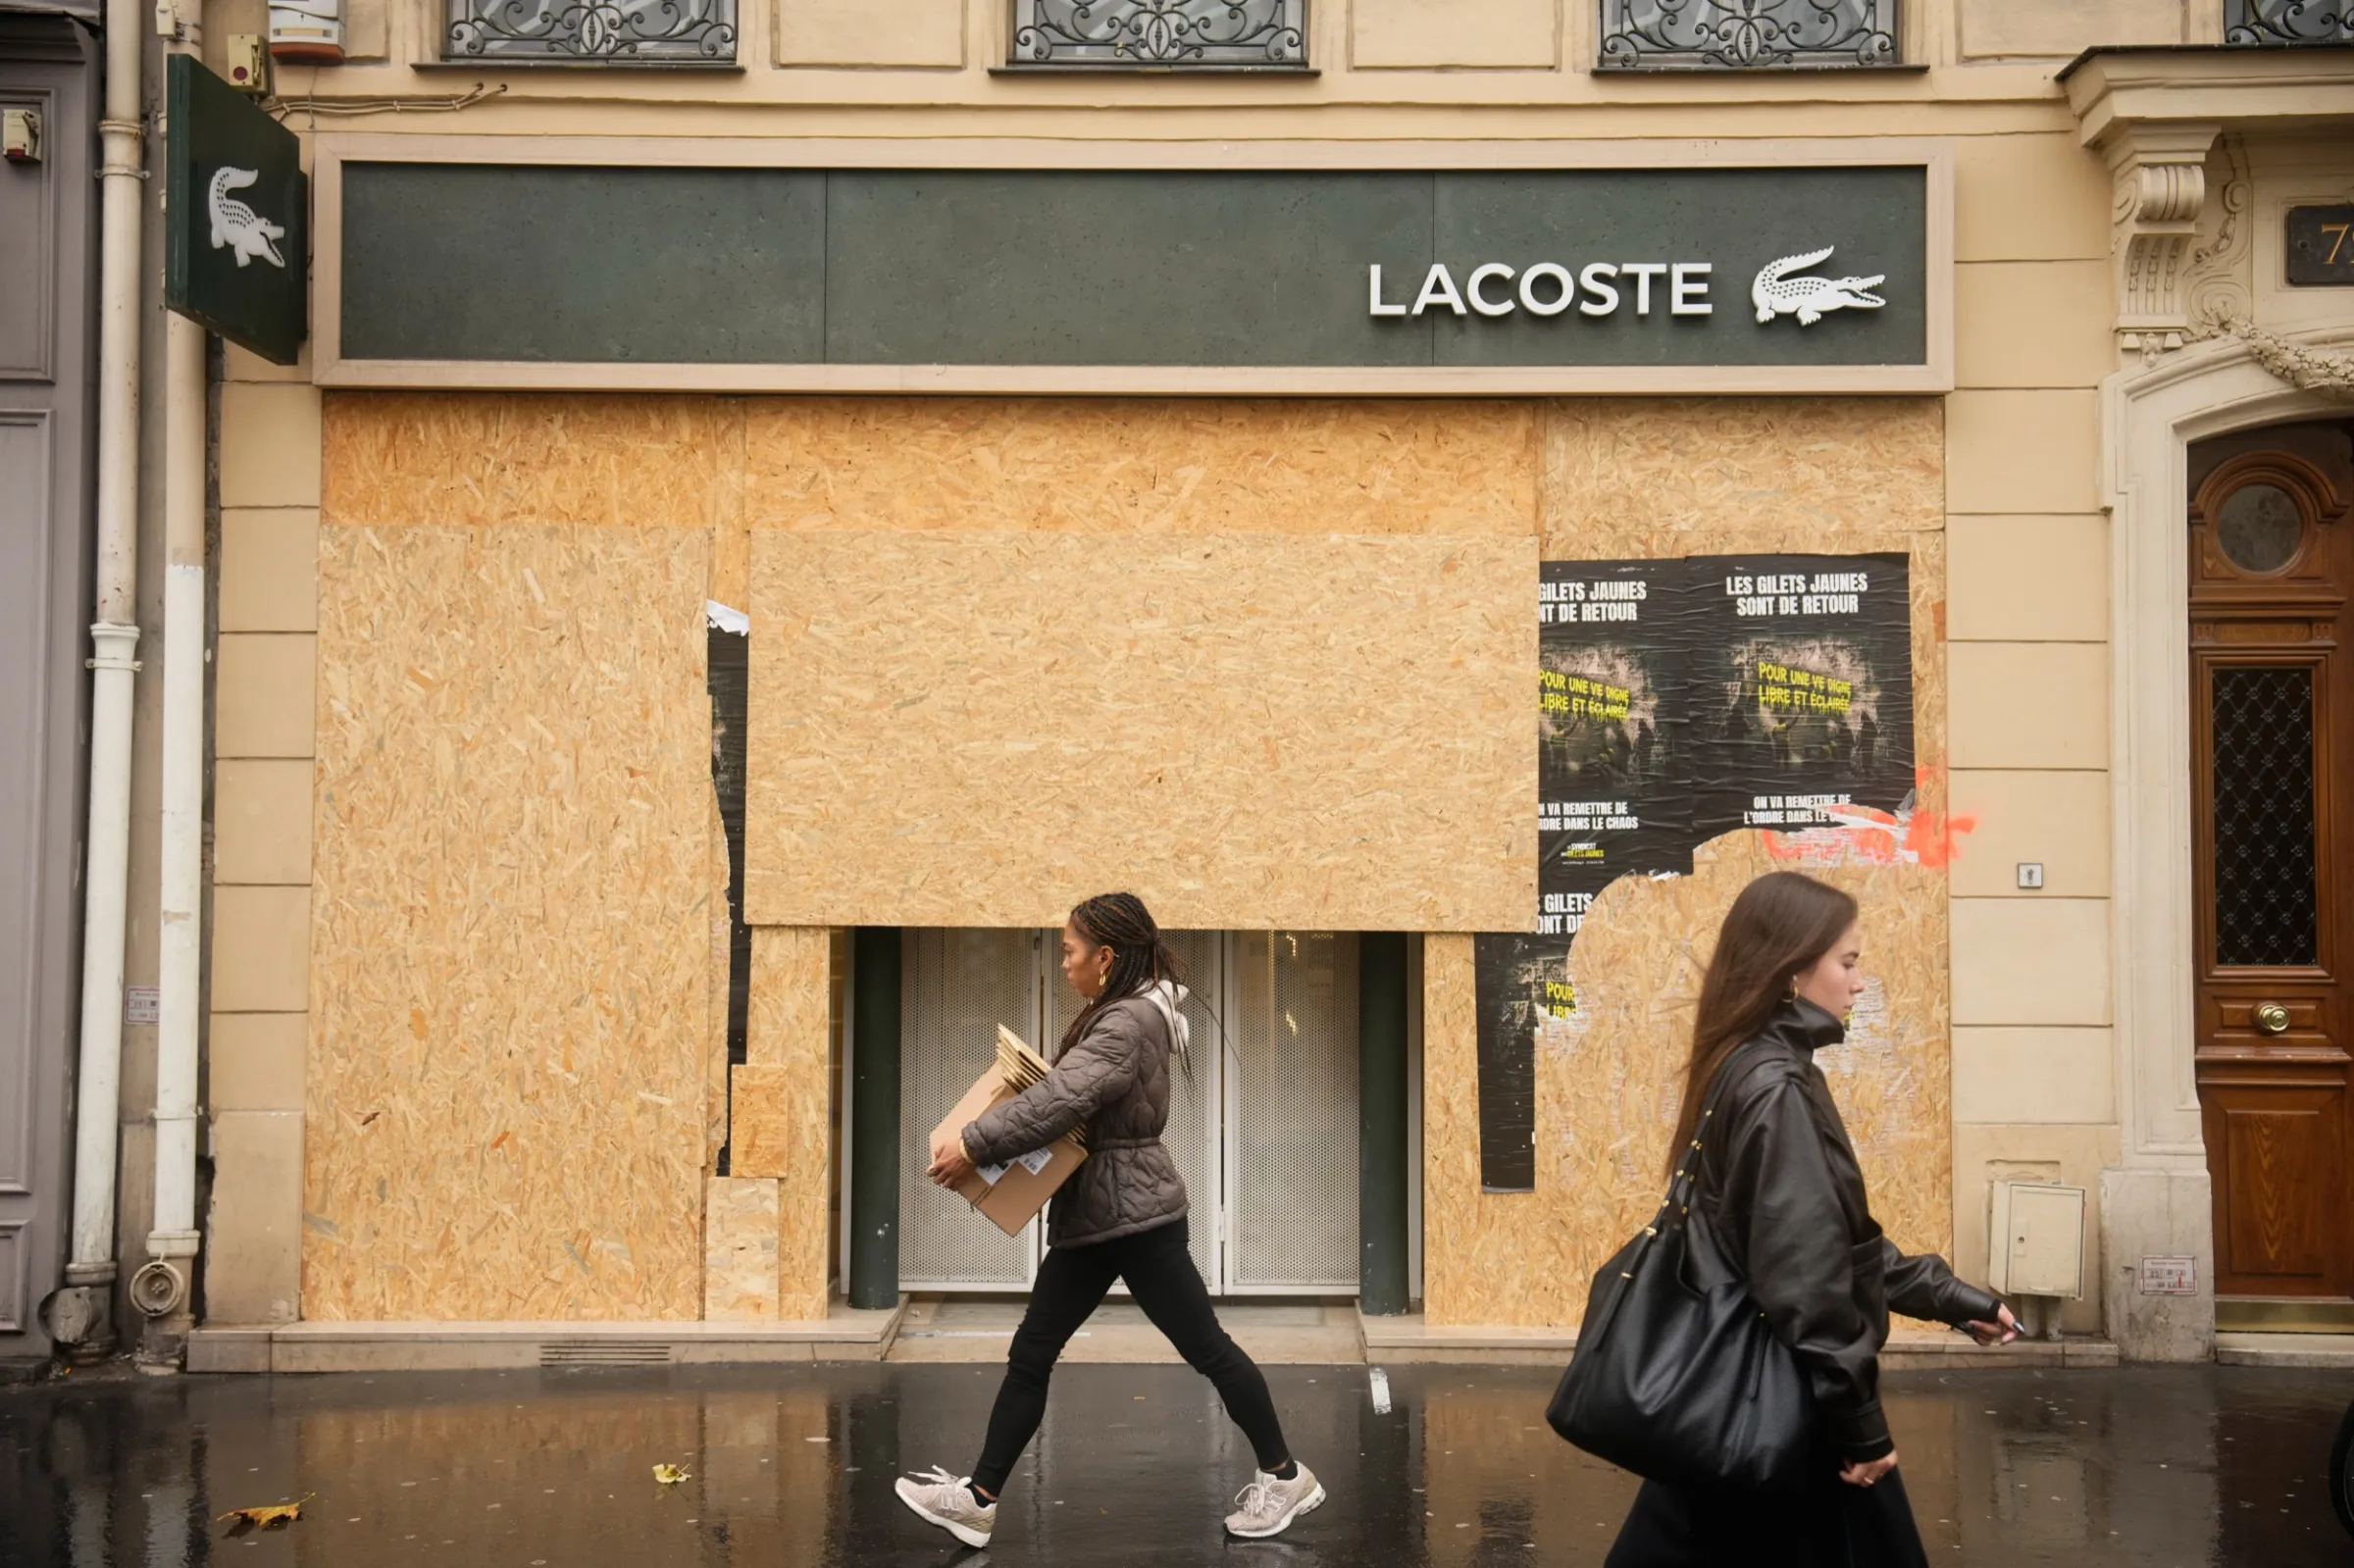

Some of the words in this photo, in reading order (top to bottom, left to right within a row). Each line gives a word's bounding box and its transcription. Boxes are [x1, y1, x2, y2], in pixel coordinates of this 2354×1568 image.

[2321, 223, 2354, 265] 7
[1369, 262, 1713, 316] LACOSTE
[1539, 582, 1586, 601] GILETS
[1589, 581, 1647, 600] JAUNES
[1726, 576, 1753, 595] LES
[1757, 575, 1806, 594] GILETS
[1810, 573, 1868, 592] JAUNES
[1539, 603, 1555, 623] NT
[1559, 603, 1577, 623] DE
[1581, 602, 1638, 622] RETOUR
[1736, 596, 1774, 616] SONT
[1779, 595, 1799, 615] DE
[1802, 594, 1859, 614] RETOUR
[1539, 669, 1566, 690] POUR
[1568, 677, 1589, 695] UNE
[1606, 685, 1630, 703] DIGNE
[1758, 661, 1787, 683] POUR
[1790, 669, 1810, 686] UNE
[1827, 679, 1852, 698] DIGNE
[1538, 691, 1569, 712] LIBRE
[1572, 697, 1586, 714] ET
[1759, 684, 1791, 705] LIBRE
[1794, 690, 1808, 706] ET
[1538, 803, 1546, 816] N
[1548, 802, 1561, 816] VA
[1562, 802, 1613, 816] REMETTRE
[1615, 801, 1628, 815] DE
[1753, 796, 1767, 809] ON
[1768, 796, 1783, 809] VA
[1538, 817, 1562, 832] RDRE
[1563, 817, 1590, 831] DANS
[1592, 817, 1605, 831] LE
[1606, 816, 1639, 831] CHAOS
[1744, 810, 1784, 825] L'ORDRE
[1786, 810, 1813, 823] DANS
[1544, 892, 1594, 913] GILETS
[1536, 914, 1562, 935] ONT
[1546, 981, 1574, 1001] POUR
